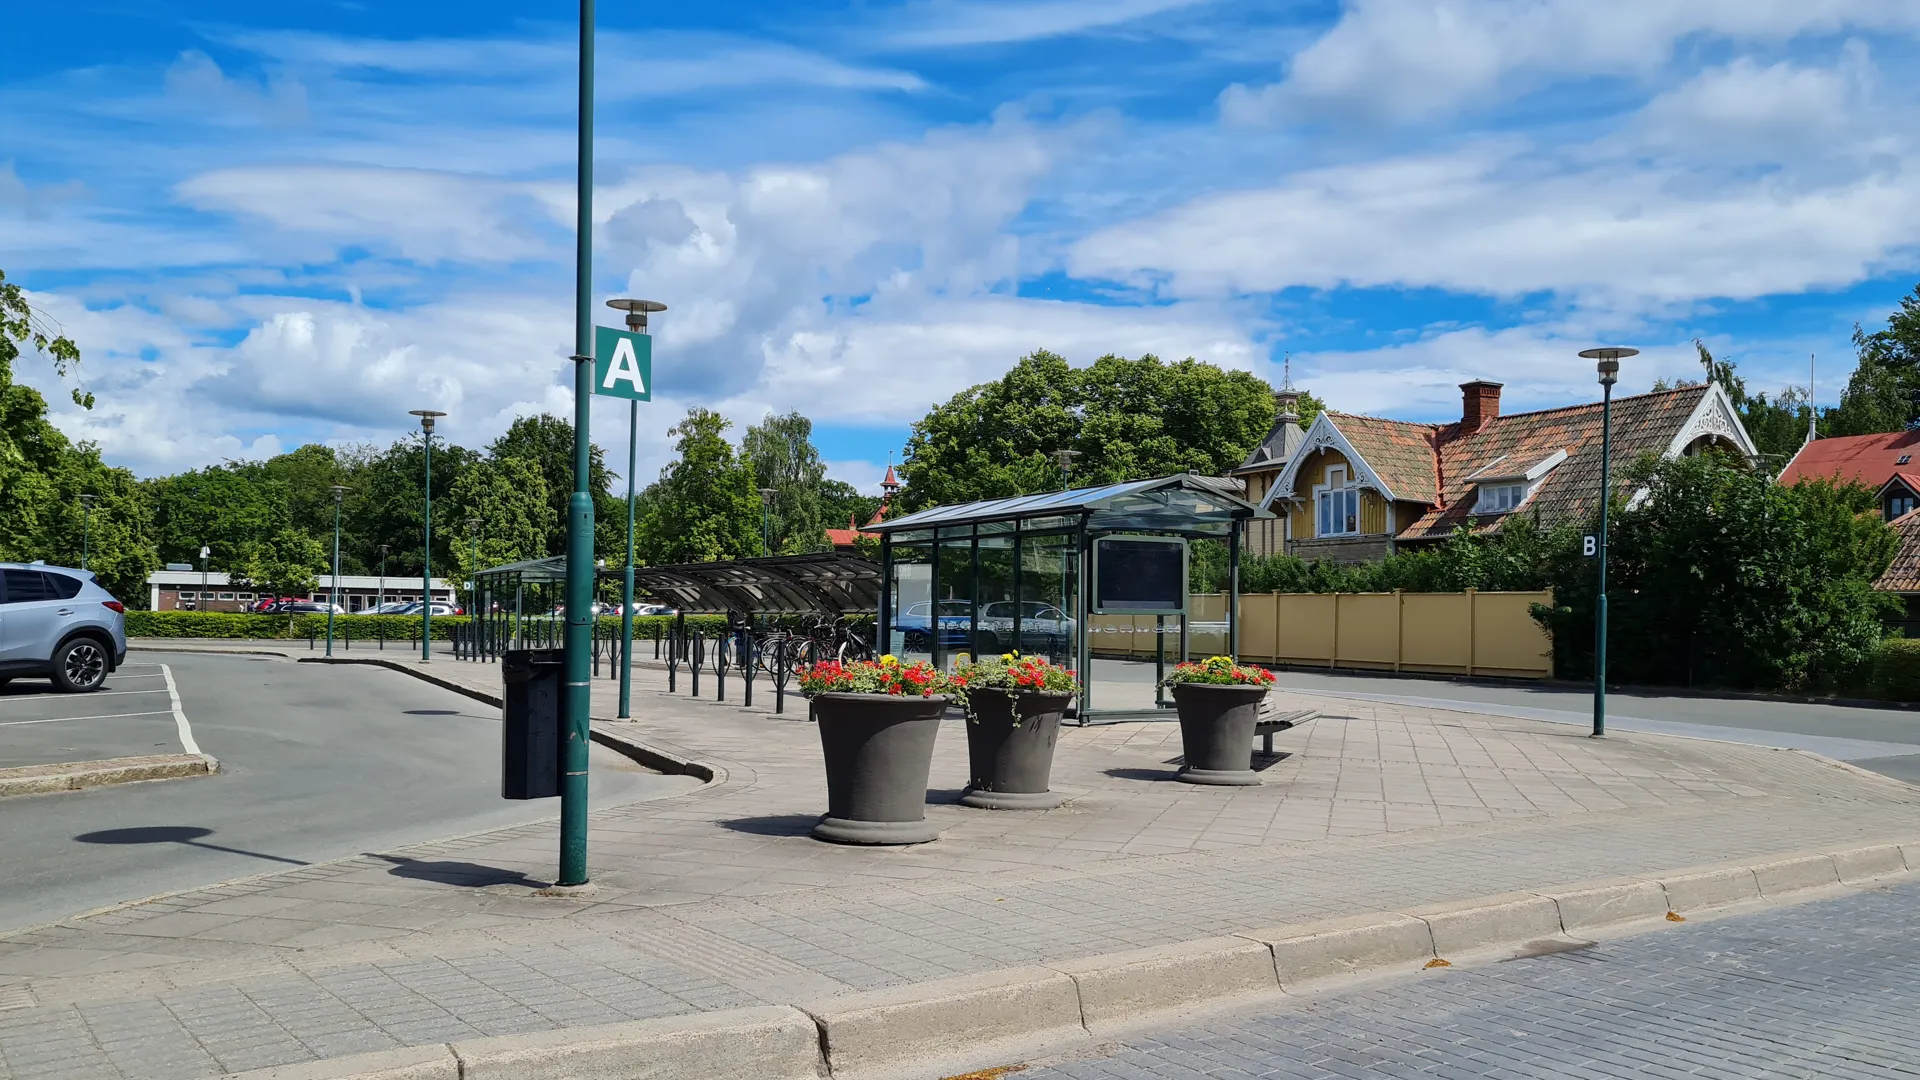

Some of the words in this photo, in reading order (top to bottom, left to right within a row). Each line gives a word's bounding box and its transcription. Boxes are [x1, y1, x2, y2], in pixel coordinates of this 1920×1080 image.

[602, 337, 645, 393] A
[1583, 535, 1596, 556] B
[463, 581, 471, 590] D
